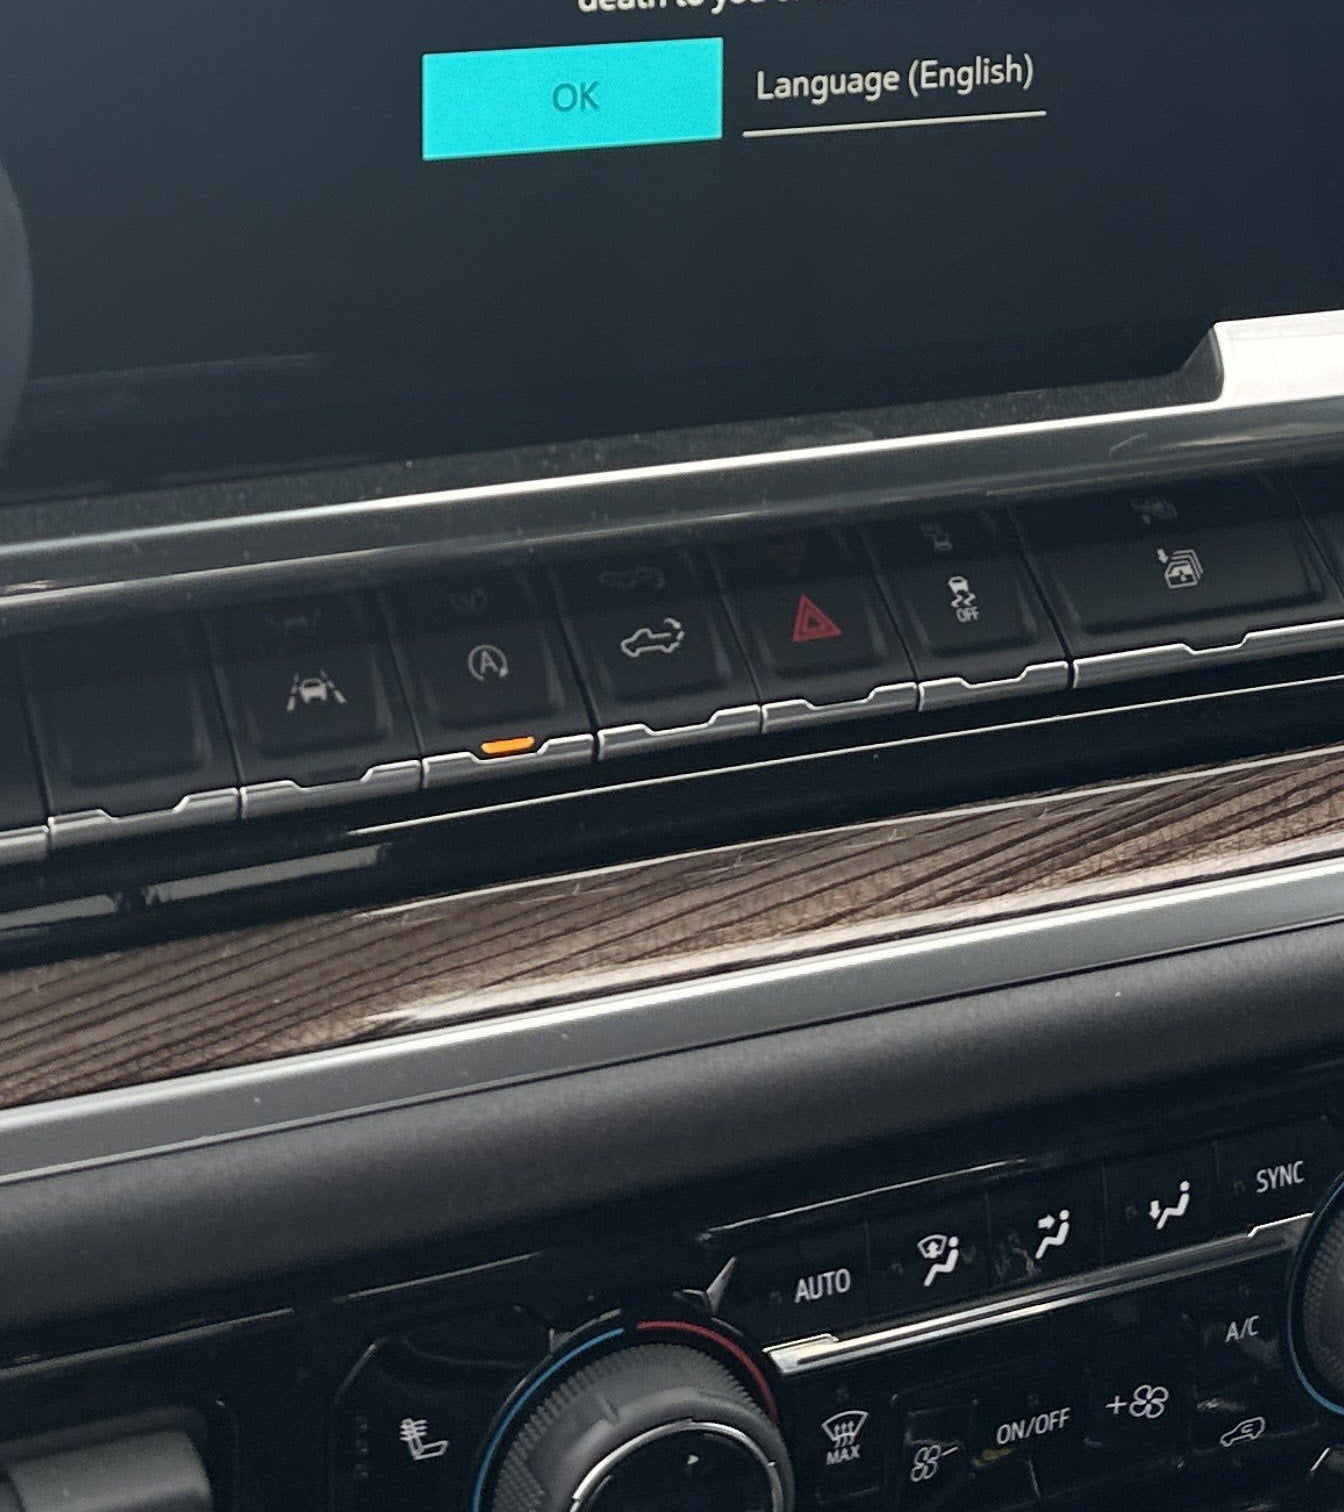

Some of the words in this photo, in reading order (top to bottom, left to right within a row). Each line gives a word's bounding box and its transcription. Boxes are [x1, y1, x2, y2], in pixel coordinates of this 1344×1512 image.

[756, 69, 903, 107] Language
[907, 51, 1036, 99] (English)
[552, 80, 601, 113] OK
[956, 606, 979, 623] OFF
[1255, 1159, 1305, 1194] SYNC
[794, 1267, 852, 1305] AUTO
[1224, 1314, 1260, 1343] A/C
[996, 1406, 1072, 1446] ON/OFF
[825, 1443, 861, 1466] MAX
